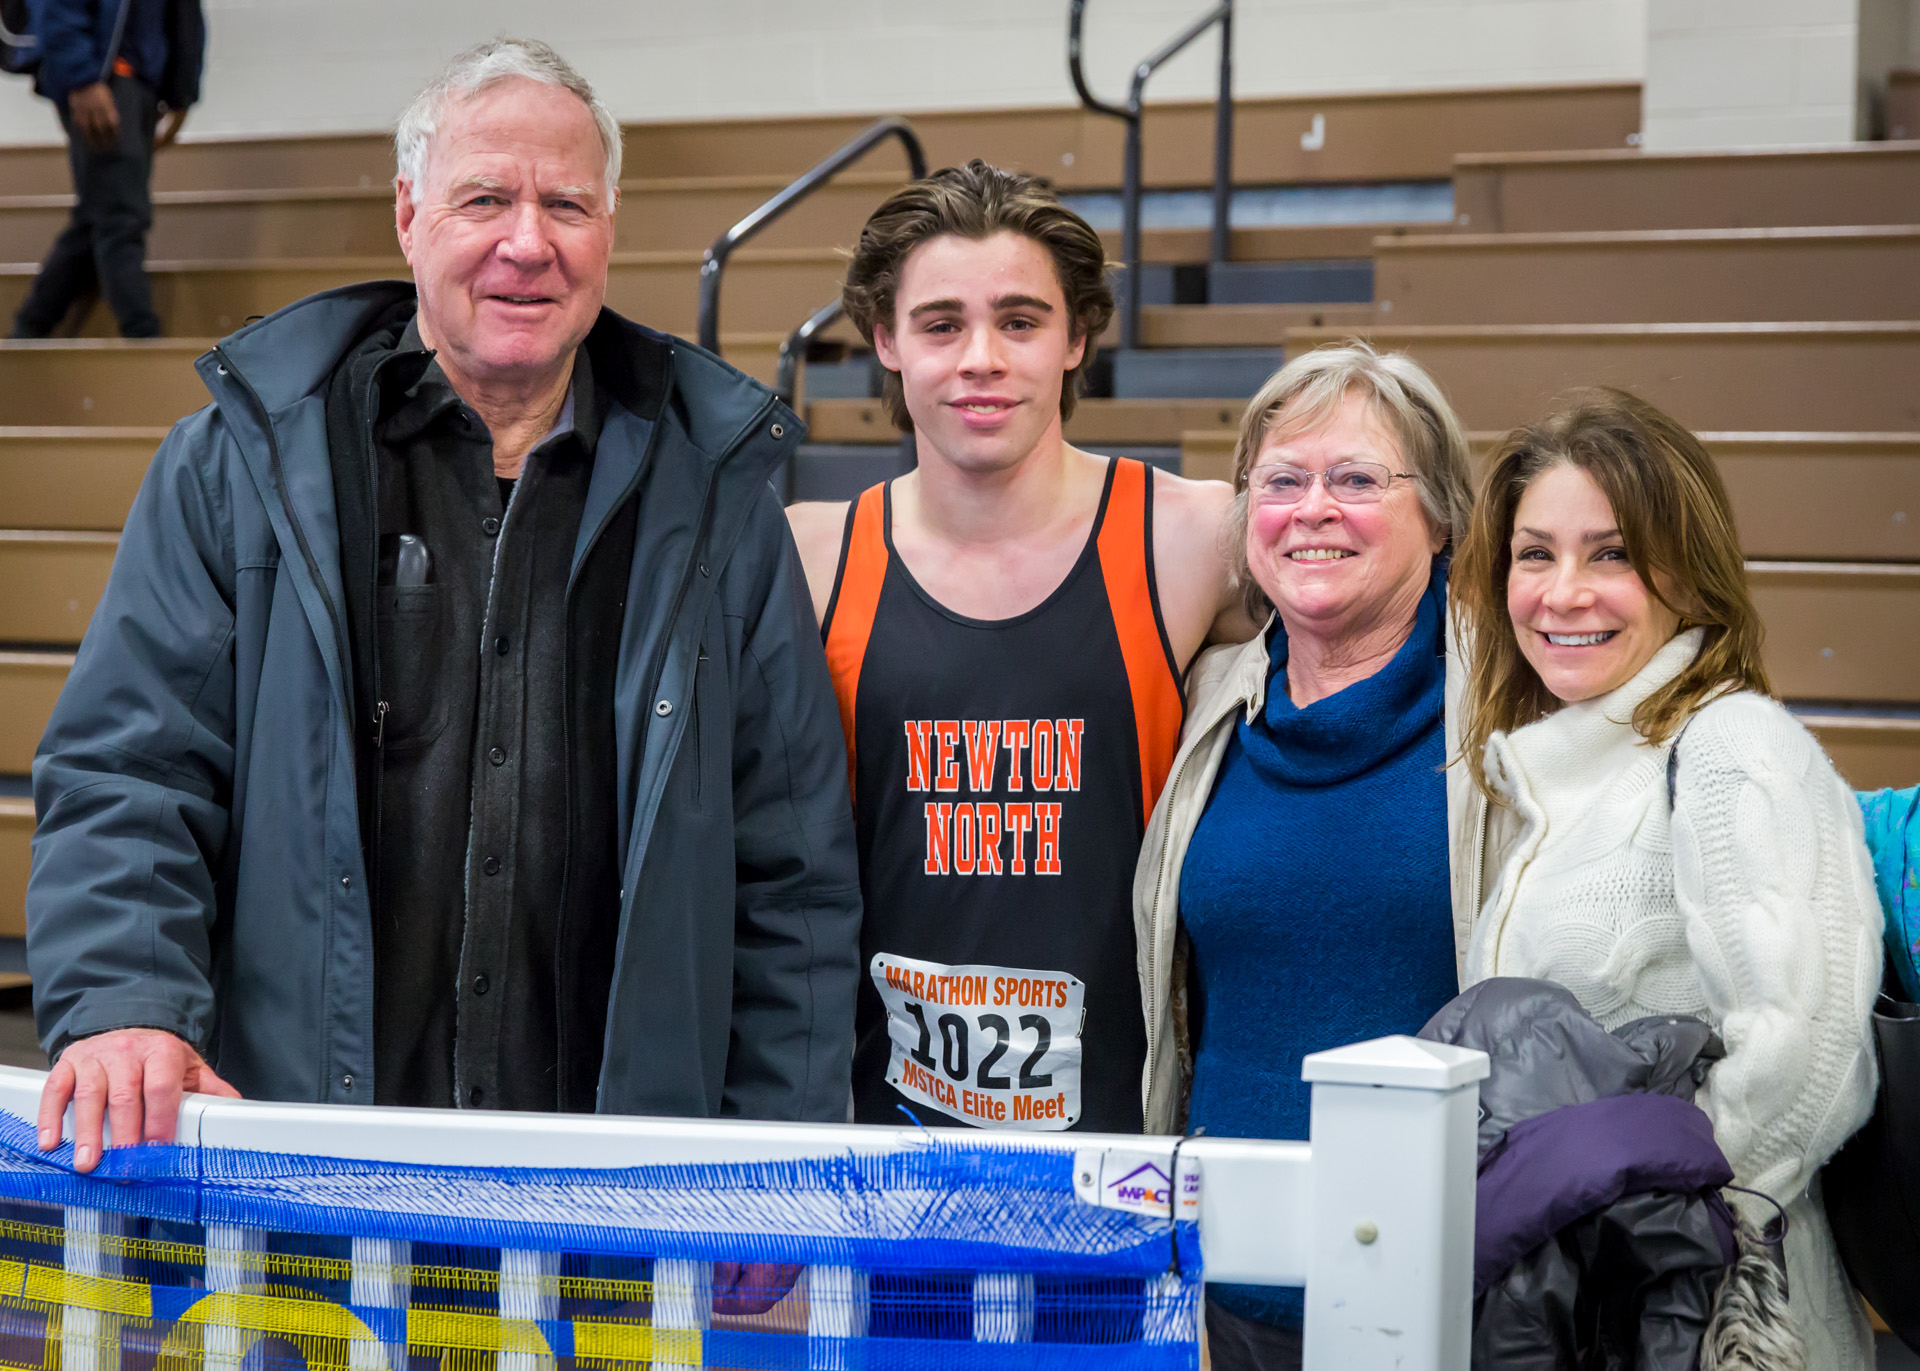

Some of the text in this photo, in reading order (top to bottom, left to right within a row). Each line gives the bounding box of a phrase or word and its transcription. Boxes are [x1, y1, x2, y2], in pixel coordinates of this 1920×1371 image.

[904, 719, 1084, 792] NEWTON
[924, 802, 1062, 875] NORTH
[885, 966, 1067, 1008] MARATHON SPORTS
[904, 1001, 1052, 1090] 1022
[902, 1058, 1065, 1121] MSTCA Elite Meet
